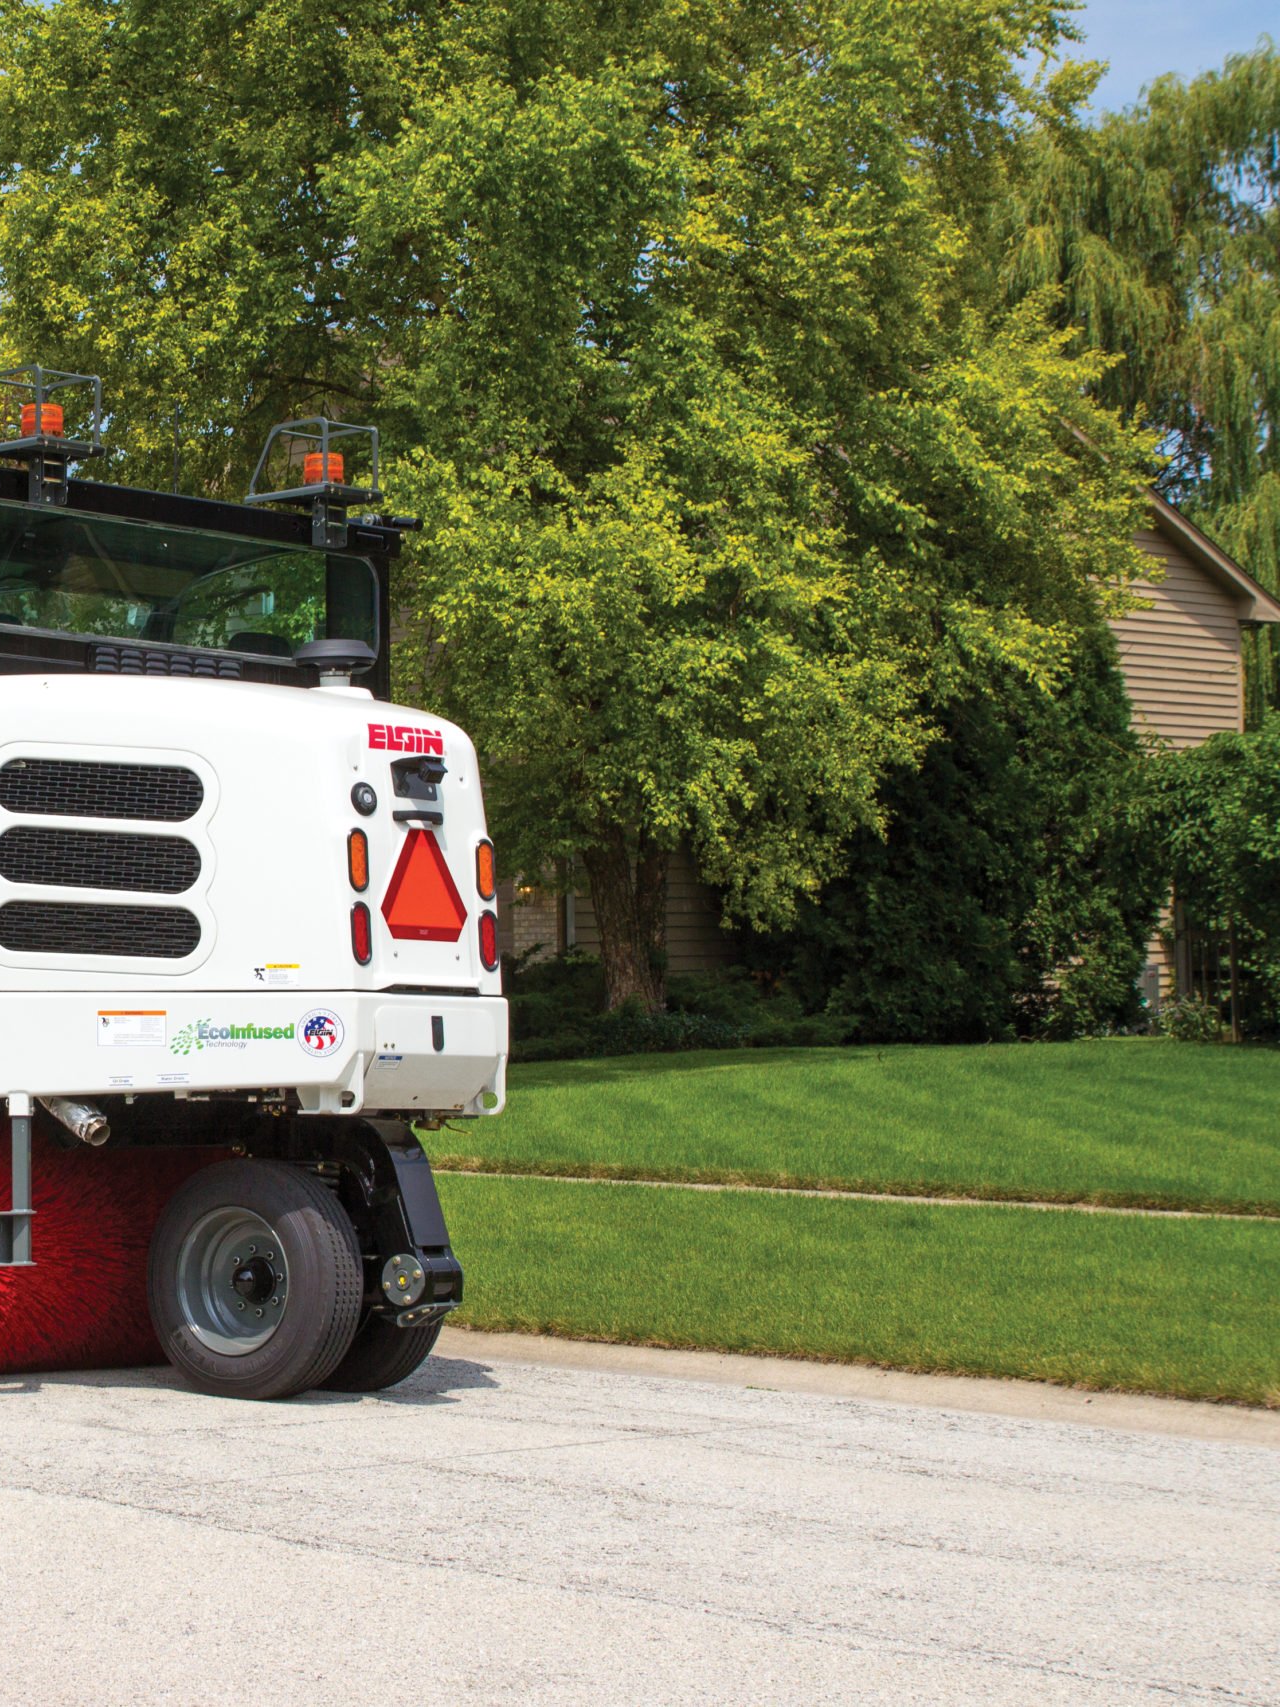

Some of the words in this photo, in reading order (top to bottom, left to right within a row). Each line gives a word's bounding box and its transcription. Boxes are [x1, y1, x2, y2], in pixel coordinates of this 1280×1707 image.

[367, 723, 443, 755] ELGIN
[198, 1022, 295, 1039] EcoInfused
[206, 1040, 248, 1049] Technology
